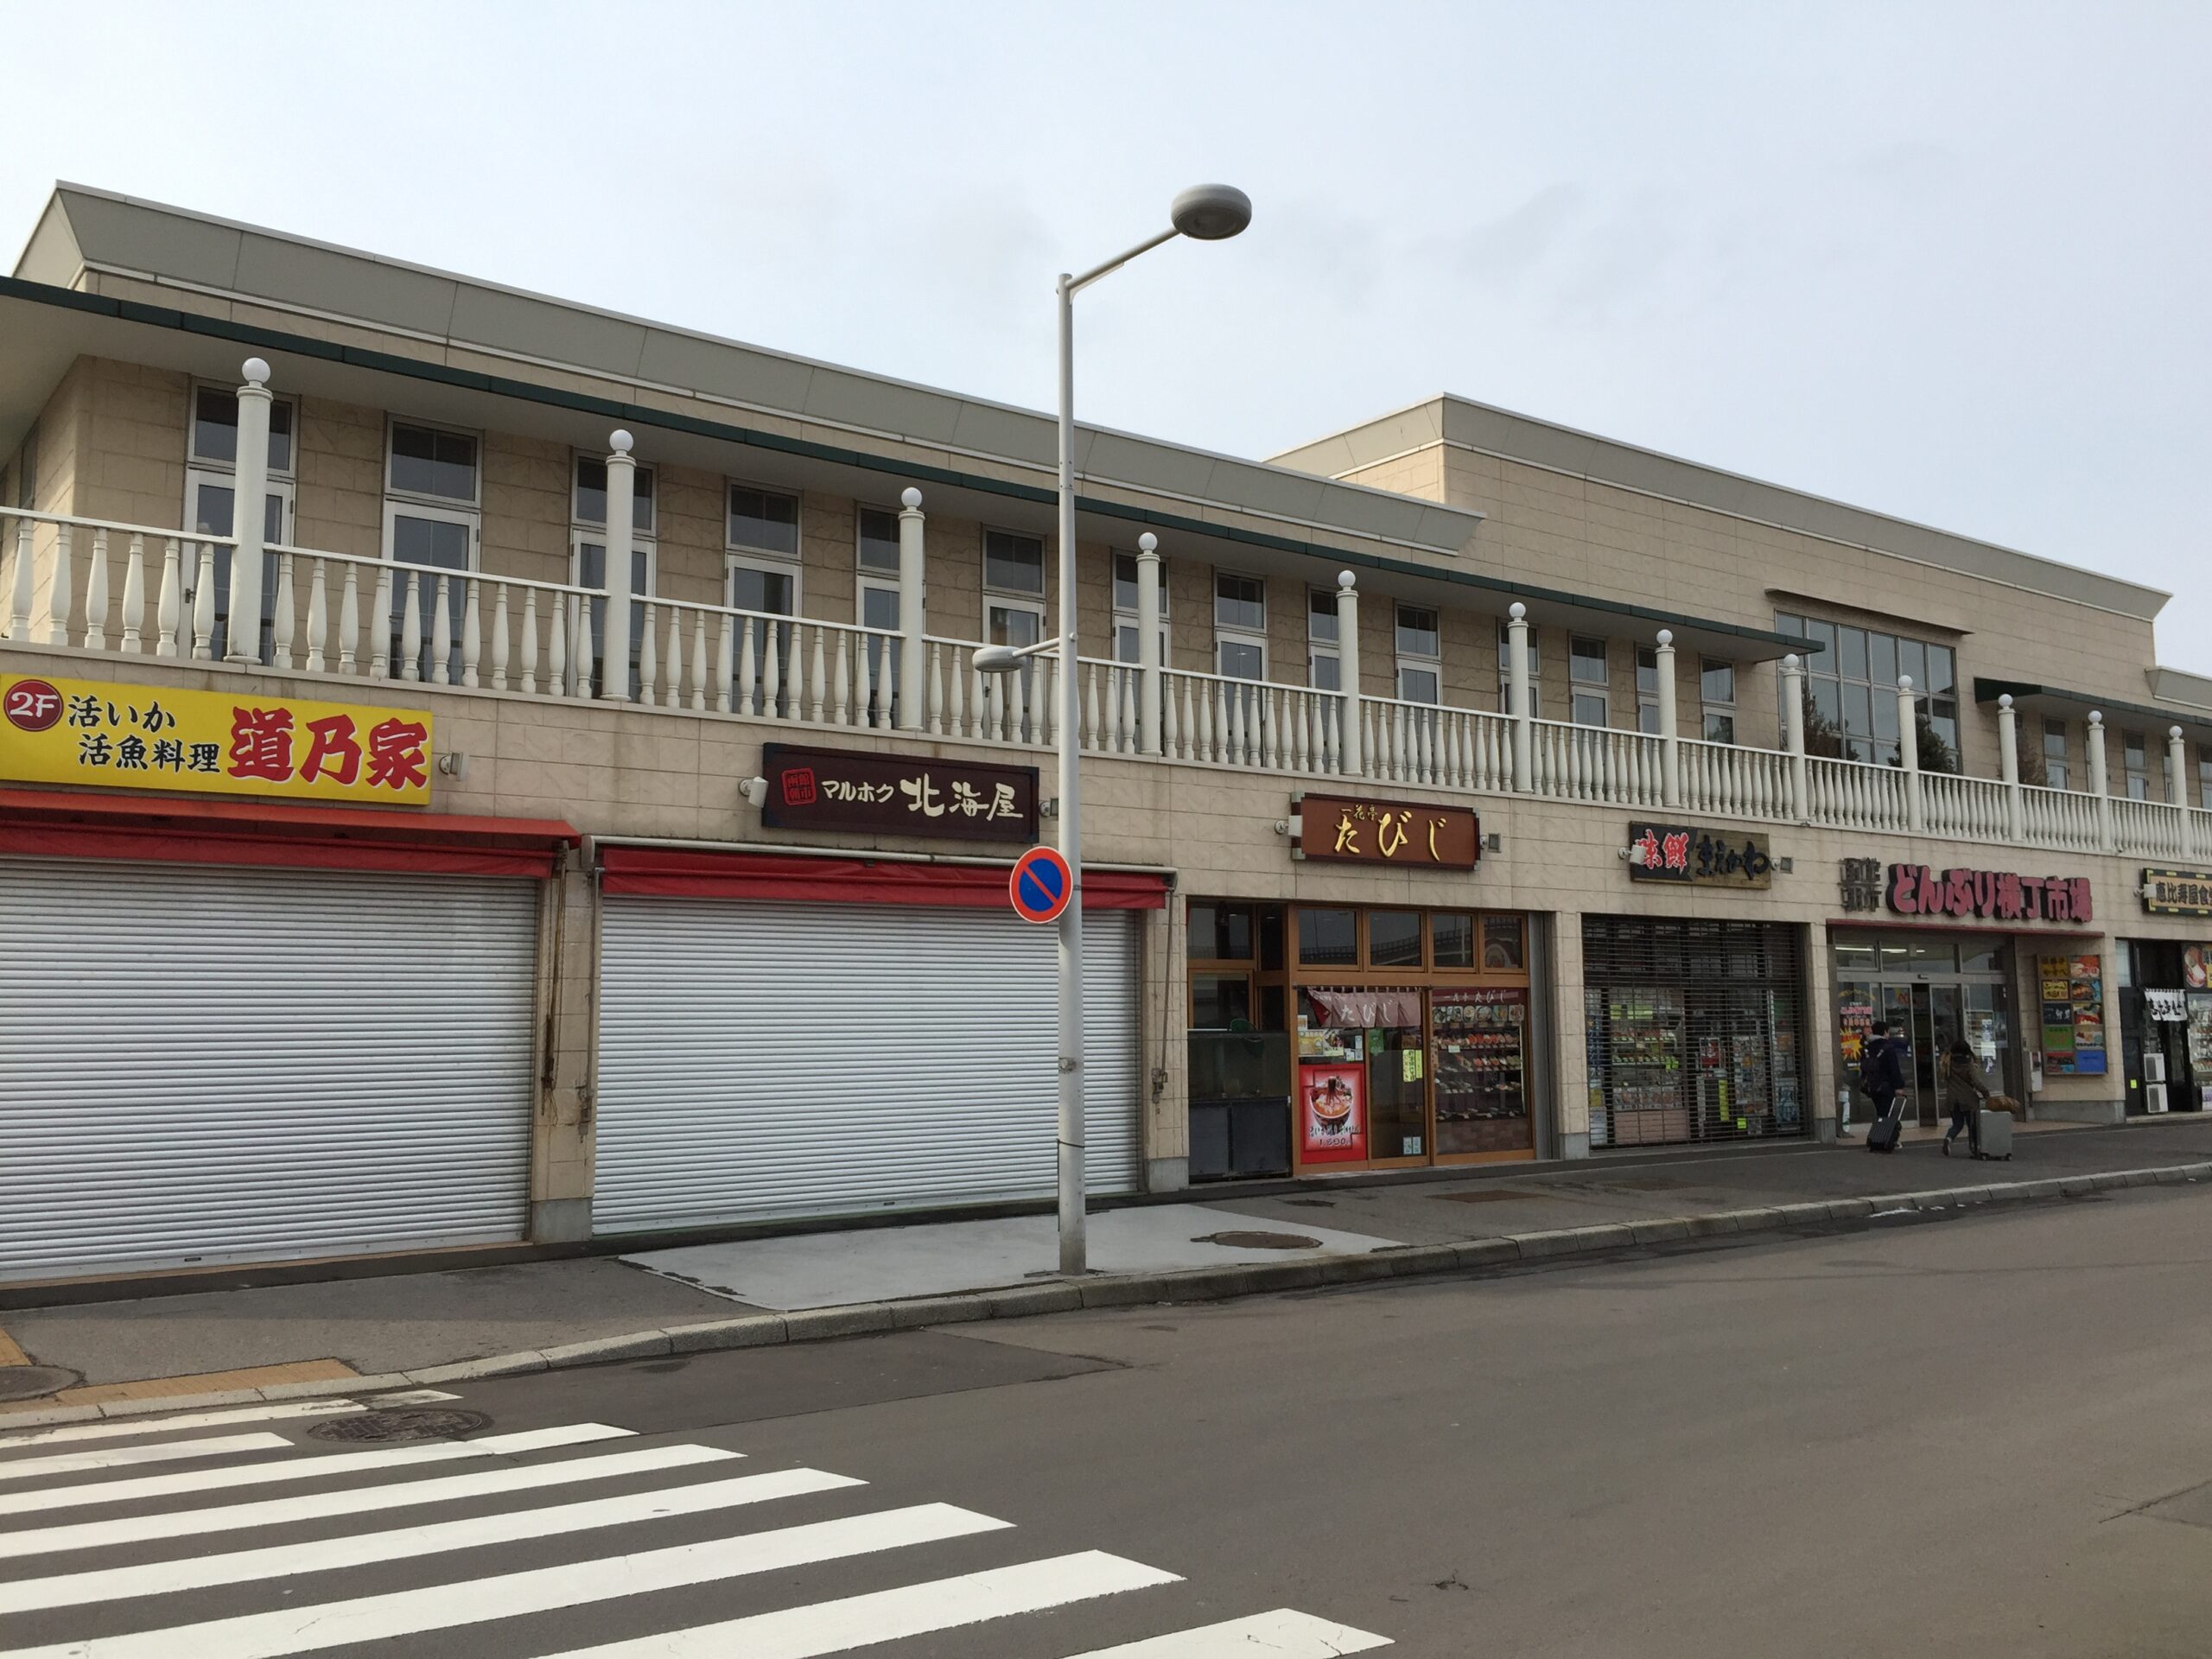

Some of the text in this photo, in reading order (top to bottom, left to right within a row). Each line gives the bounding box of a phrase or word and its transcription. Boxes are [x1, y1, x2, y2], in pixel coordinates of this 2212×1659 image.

[10, 692, 59, 718] 2F
[68, 695, 175, 734] 活いか
[78, 734, 221, 773] 活魚料理
[227, 706, 429, 790] 道乃家
[822, 773, 1024, 821] マルホク 北海屋
[1341, 804, 1378, 821] 一花亭
[1334, 810, 1447, 861] たびじ
[1887, 863, 2093, 923] どんぶり横丁市場
[2156, 881, 2212, 906] 恵比寿屋食
[1340, 999, 1394, 1023] たびじ
